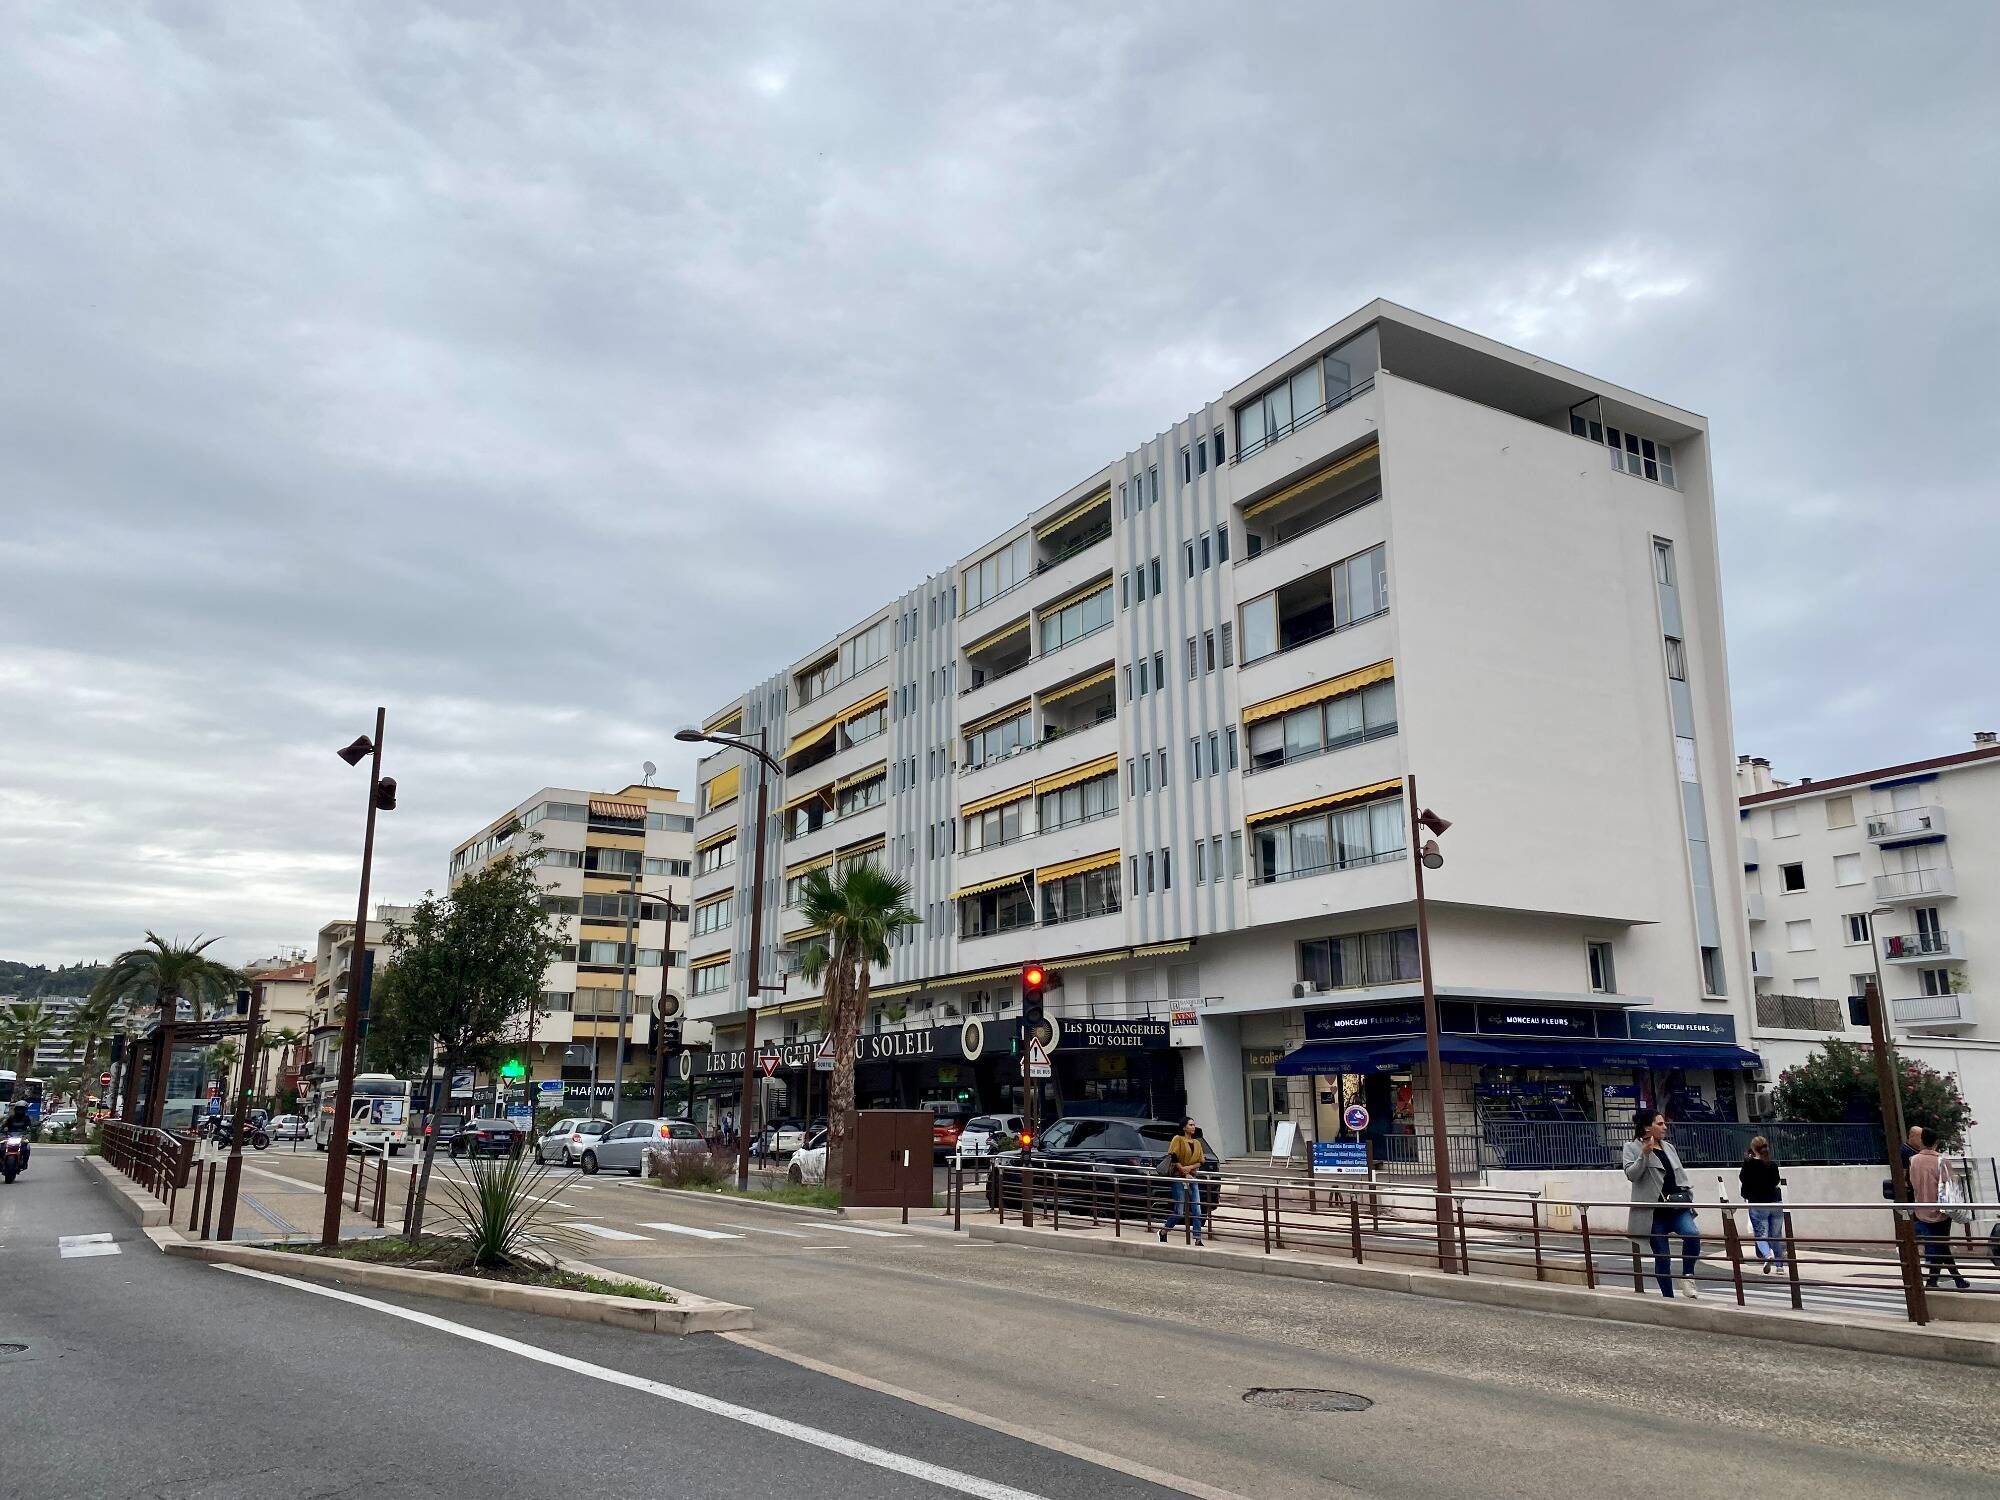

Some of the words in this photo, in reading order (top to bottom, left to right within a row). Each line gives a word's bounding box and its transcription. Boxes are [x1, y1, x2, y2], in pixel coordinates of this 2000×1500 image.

[1334, 1018, 1368, 1027] MONCEAU
[1370, 1016, 1400, 1025] FLEURS
[1506, 1016, 1540, 1024] MONCEAU
[1541, 1017, 1569, 1026] FLEURS
[1064, 1022, 1083, 1033] LES
[1086, 1023, 1166, 1035] BOULANGERIES
[1656, 1023, 1685, 1031] MONCEAU
[1686, 1024, 1710, 1032] FLEURS
[1088, 1035, 1104, 1045] DU
[1107, 1036, 1144, 1046] SOLEIL
[706, 1053, 726, 1072] LES
[855, 1038, 864, 1059] U
[872, 1031, 934, 1058] SOLEIL
[1249, 1052, 1258, 1065] le
